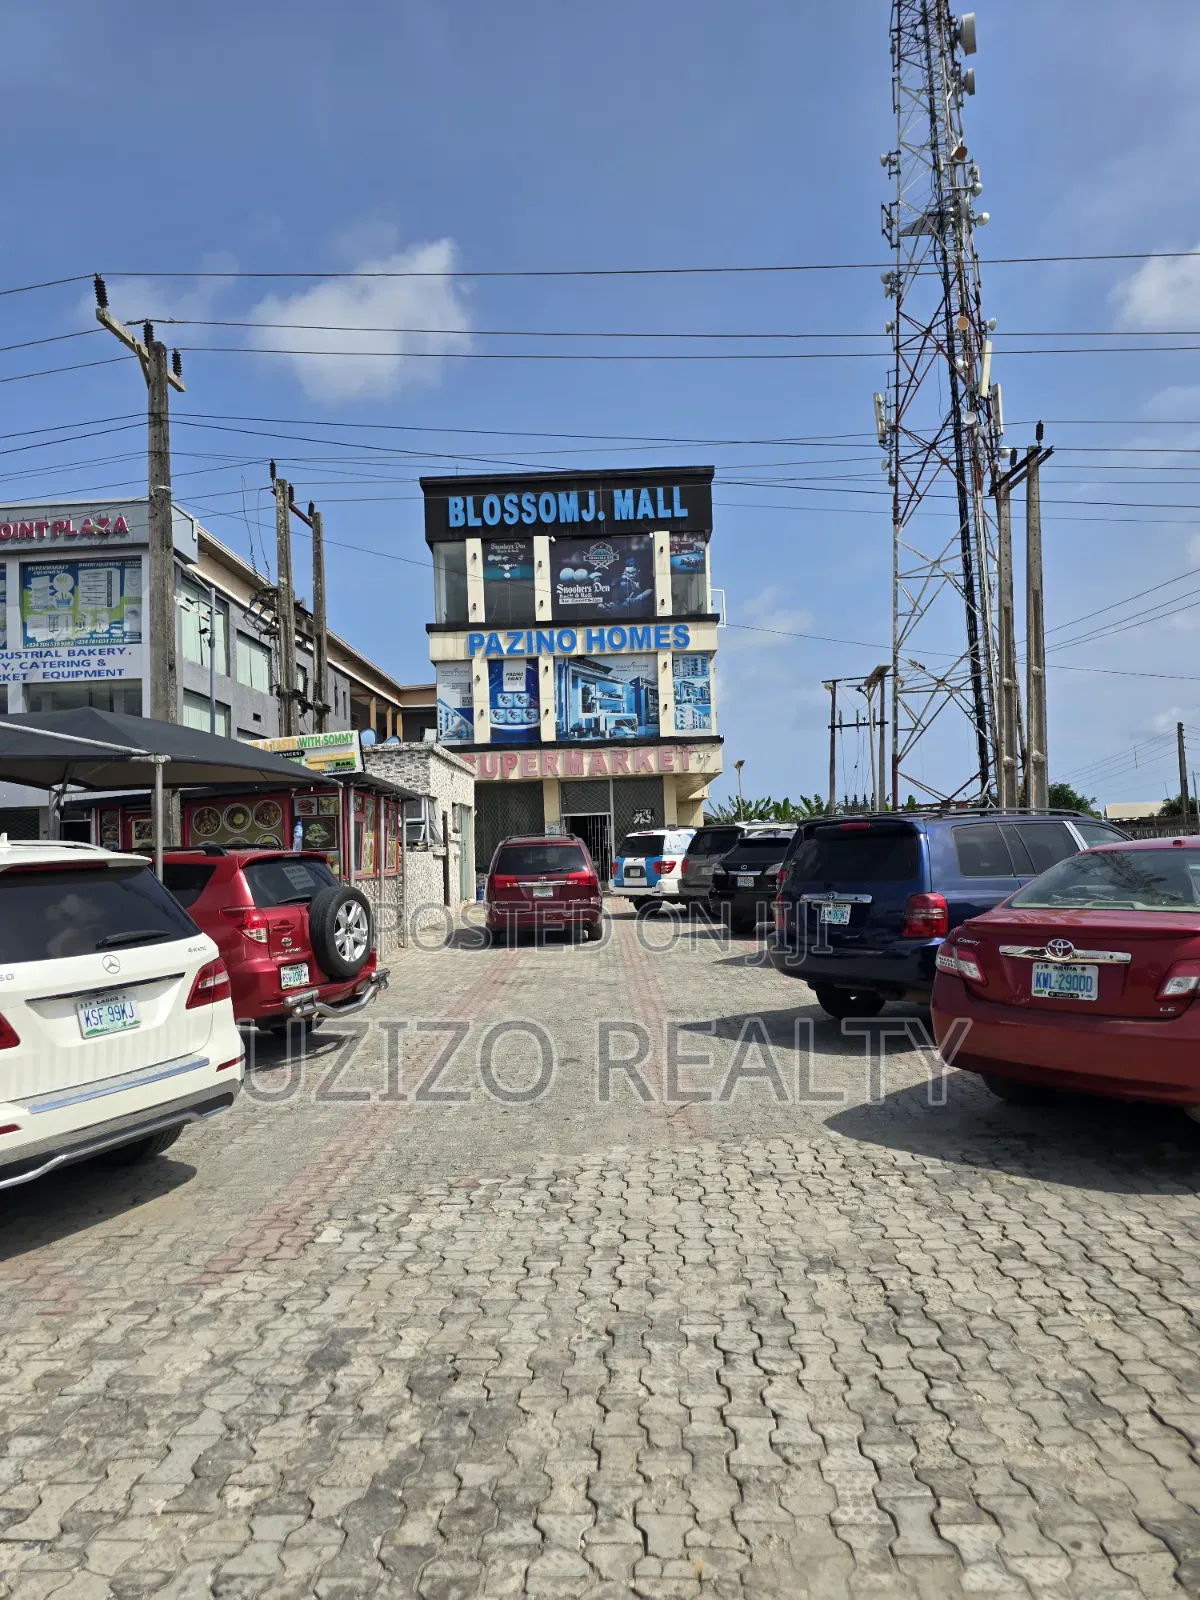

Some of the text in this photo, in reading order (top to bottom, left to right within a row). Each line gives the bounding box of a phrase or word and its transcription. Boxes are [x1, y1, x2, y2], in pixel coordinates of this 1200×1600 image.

[613, 486, 689, 521] MALL
[52, 516, 129, 537] PLAZA
[467, 624, 691, 657] PAZINO HOMES
[19, 659, 91, 670] CATERING
[97, 658, 106, 666] &
[0, 668, 125, 681] KET EQUIPMENT
[263, 740, 270, 752] A
[270, 737, 297, 752] TASTE
[298, 736, 320, 749] WITH
[322, 732, 354, 746] SOMMY
